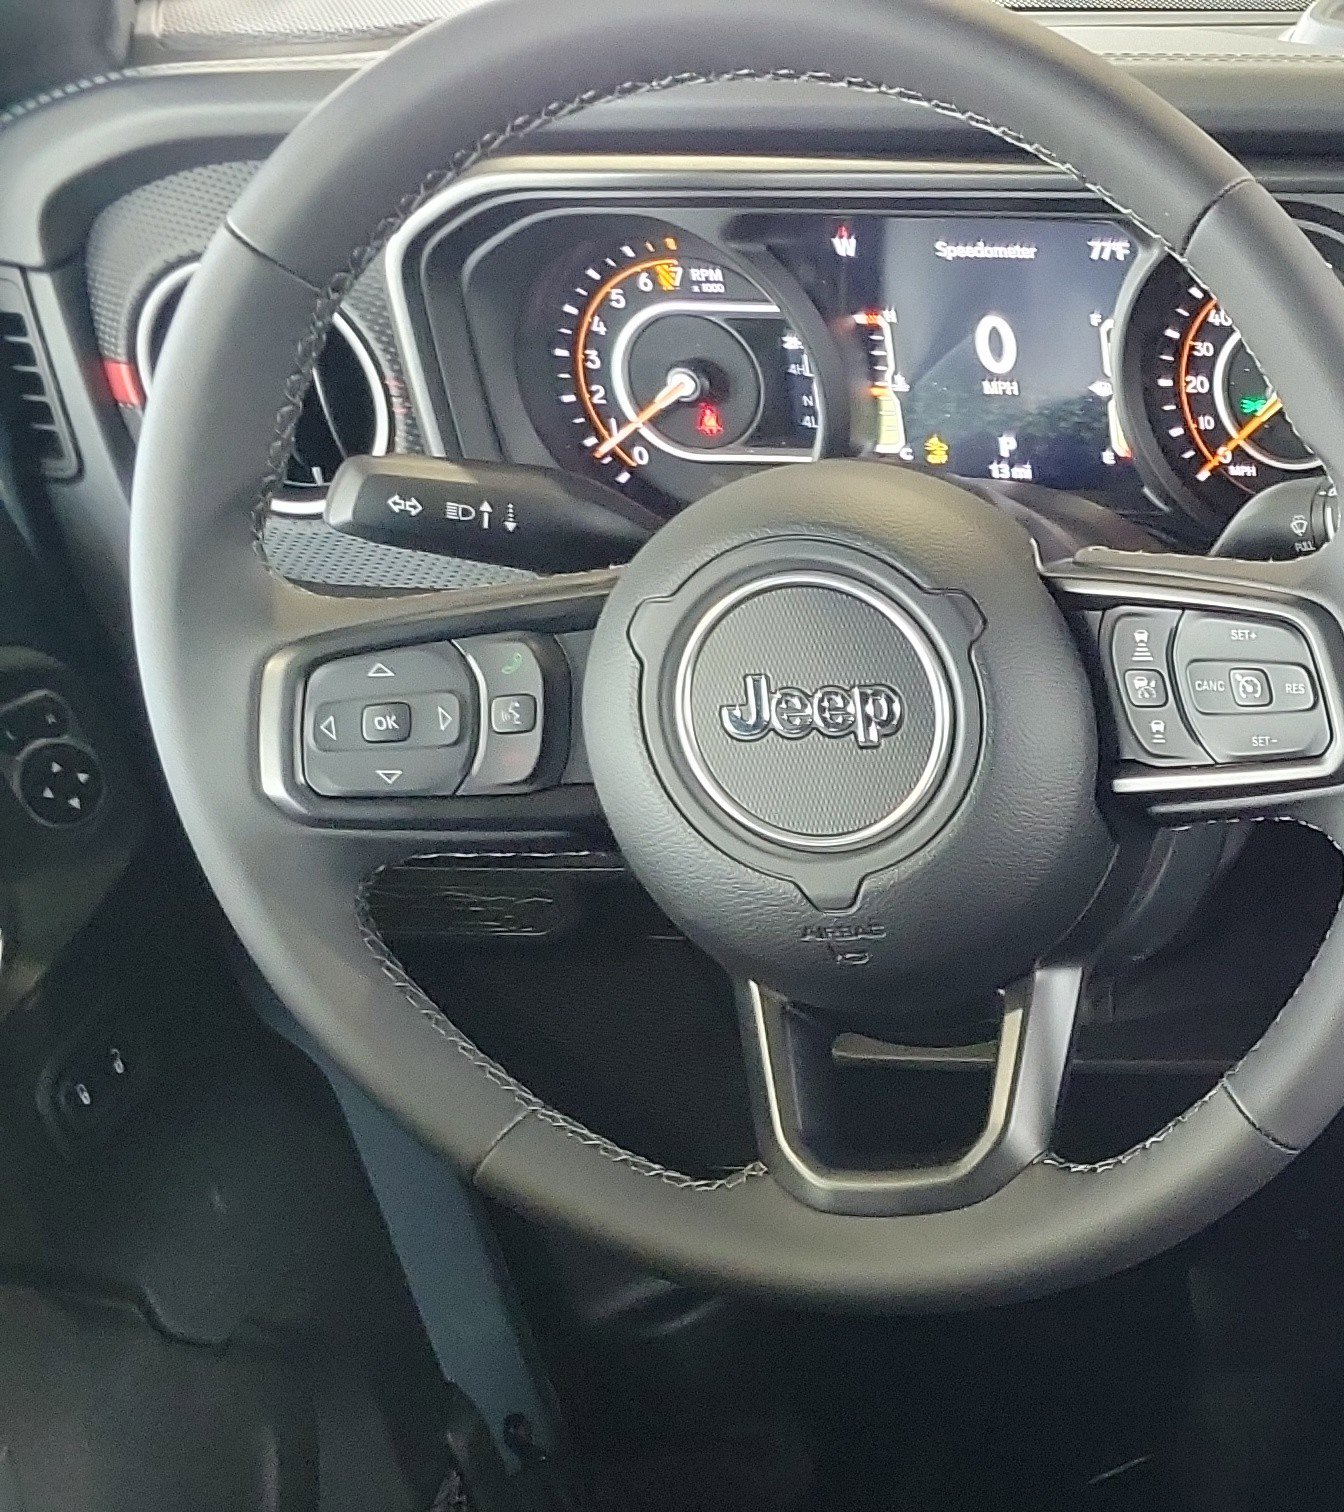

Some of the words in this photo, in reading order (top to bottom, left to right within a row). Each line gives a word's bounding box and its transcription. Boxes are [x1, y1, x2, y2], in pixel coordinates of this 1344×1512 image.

[831, 237, 857, 257] W
[934, 239, 1037, 260] Speedometer
[637, 272, 653, 292] 6
[669, 266, 683, 287] 7
[690, 268, 723, 281] RPM
[609, 288, 626, 309] 5
[591, 315, 607, 335] 4
[1208, 309, 1232, 326] 40
[974, 314, 1017, 374] 0
[1192, 341, 1214, 357] 30
[584, 349, 601, 369] 3
[981, 380, 1019, 395] MPH
[1185, 375, 1209, 393] 20
[590, 385, 607, 404] 2
[1198, 416, 1215, 430] 10
[900, 448, 914, 461] C
[997, 433, 1018, 458] P
[632, 446, 649, 465] 0
[1228, 465, 1257, 477] MPH
[1195, 681, 1225, 692] CANC
[1285, 683, 1305, 694] RES
[719, 673, 902, 749] Jeep
[374, 714, 399, 732] OK
